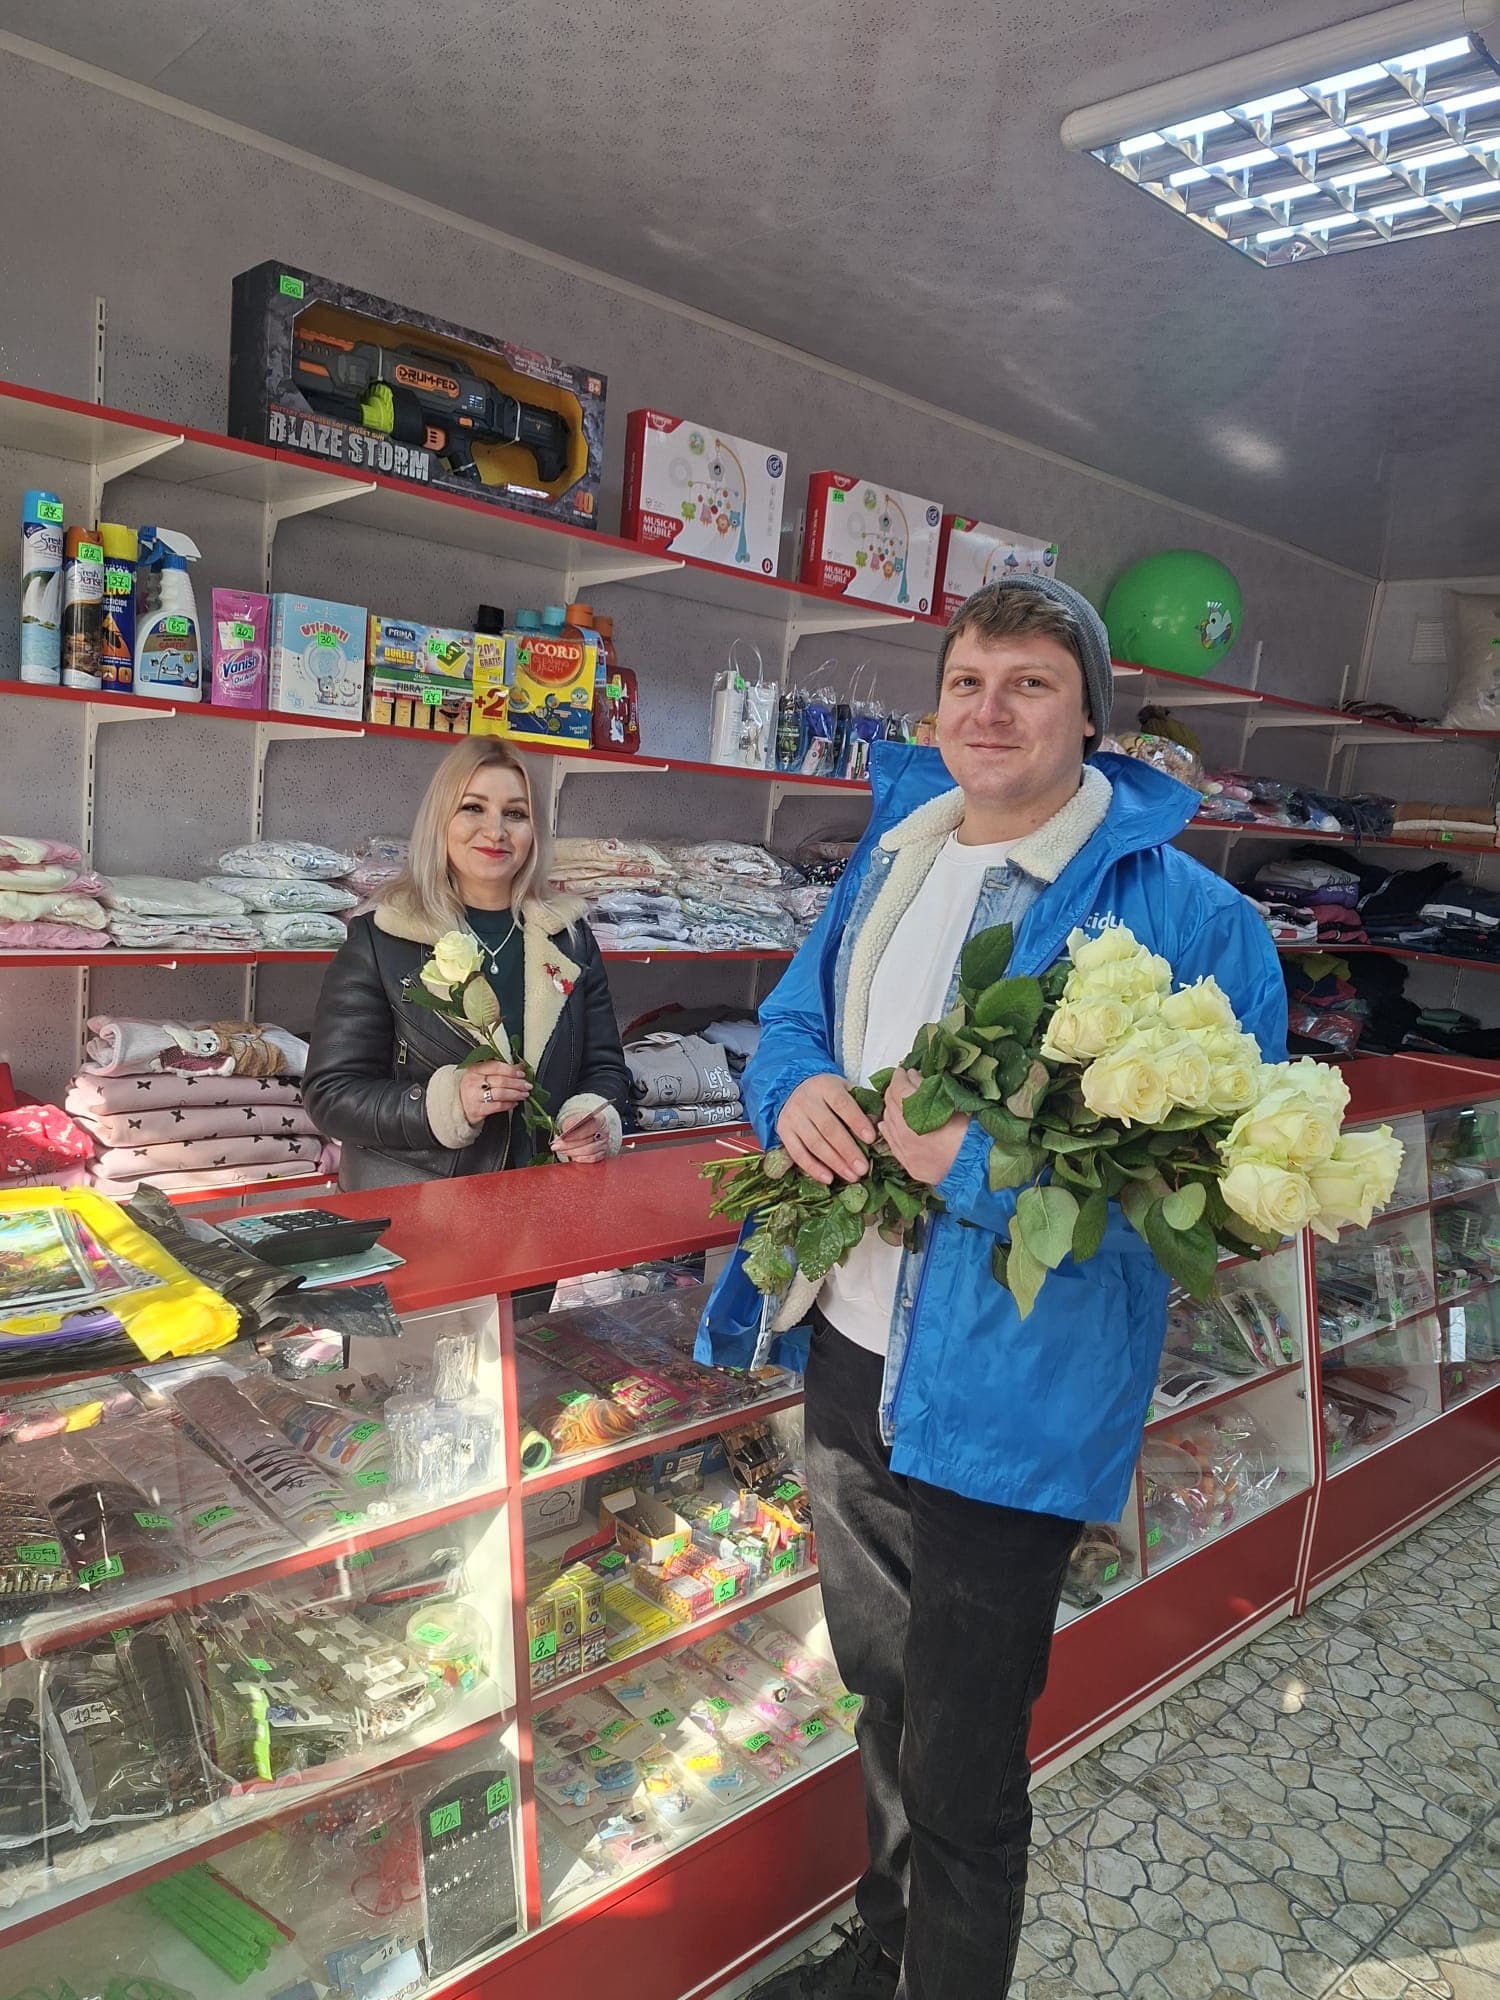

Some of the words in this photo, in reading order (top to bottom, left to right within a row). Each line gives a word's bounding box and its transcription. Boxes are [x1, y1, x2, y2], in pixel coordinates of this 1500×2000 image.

[399, 366, 458, 391] DRUM-FED
[269, 411, 343, 459] BLAZE
[348, 432, 430, 482] STORM
[643, 515, 678, 531] MUSICAL
[642, 523, 673, 538] MOBILE
[824, 564, 852, 578] MUSICAL
[823, 573, 847, 585] MOBILE
[388, 627, 413, 640] PRIMA
[477, 643, 500, 657] 20%
[525, 640, 581, 660] ACORD
[222, 654, 258, 679] Vanish
[479, 656, 502, 667] GRATIS
[396, 682, 421, 693] FIBRA
[704, 1066, 733, 1089] Let's
[585, 1595, 603, 1609] 101
[560, 1605, 577, 1619] 101
[534, 1616, 552, 1628] 101
